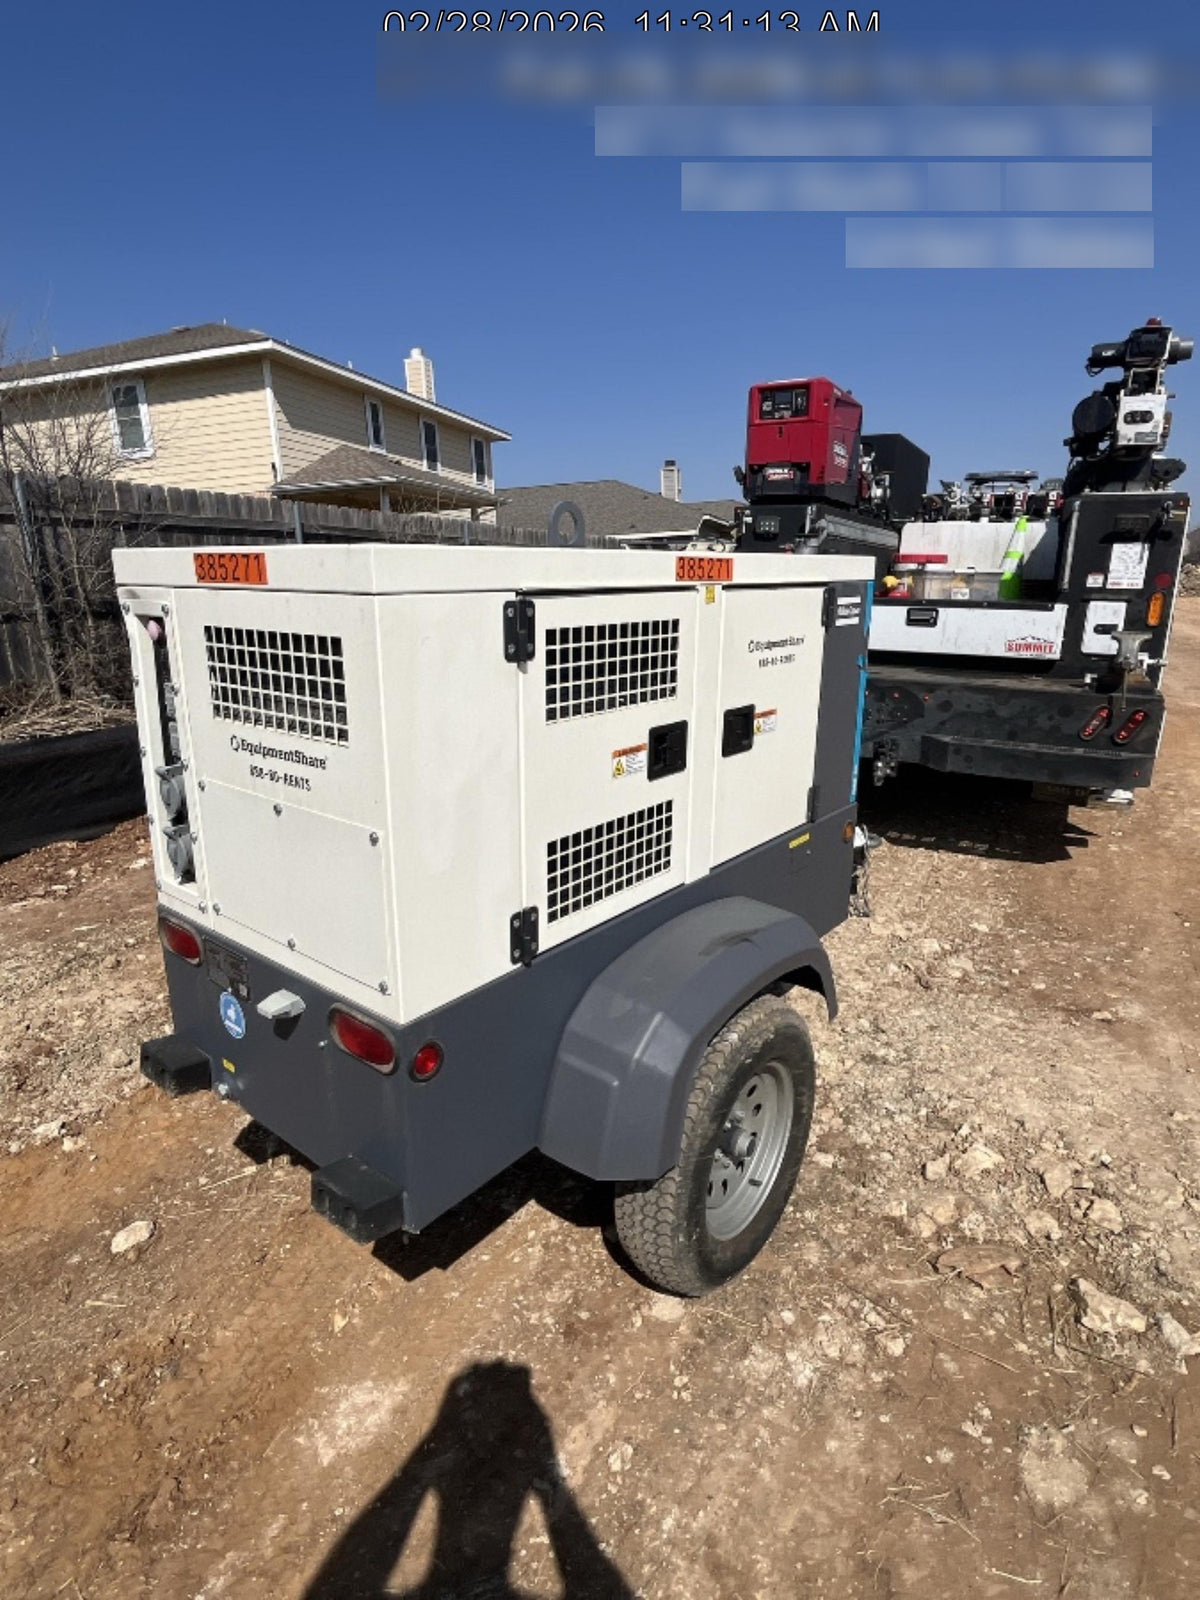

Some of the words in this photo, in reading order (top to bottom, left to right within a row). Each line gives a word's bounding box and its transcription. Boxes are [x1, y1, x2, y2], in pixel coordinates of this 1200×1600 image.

[195, 553, 263, 582] 385271
[676, 557, 730, 580] 385271
[240, 738, 327, 770] EquipmentShare
